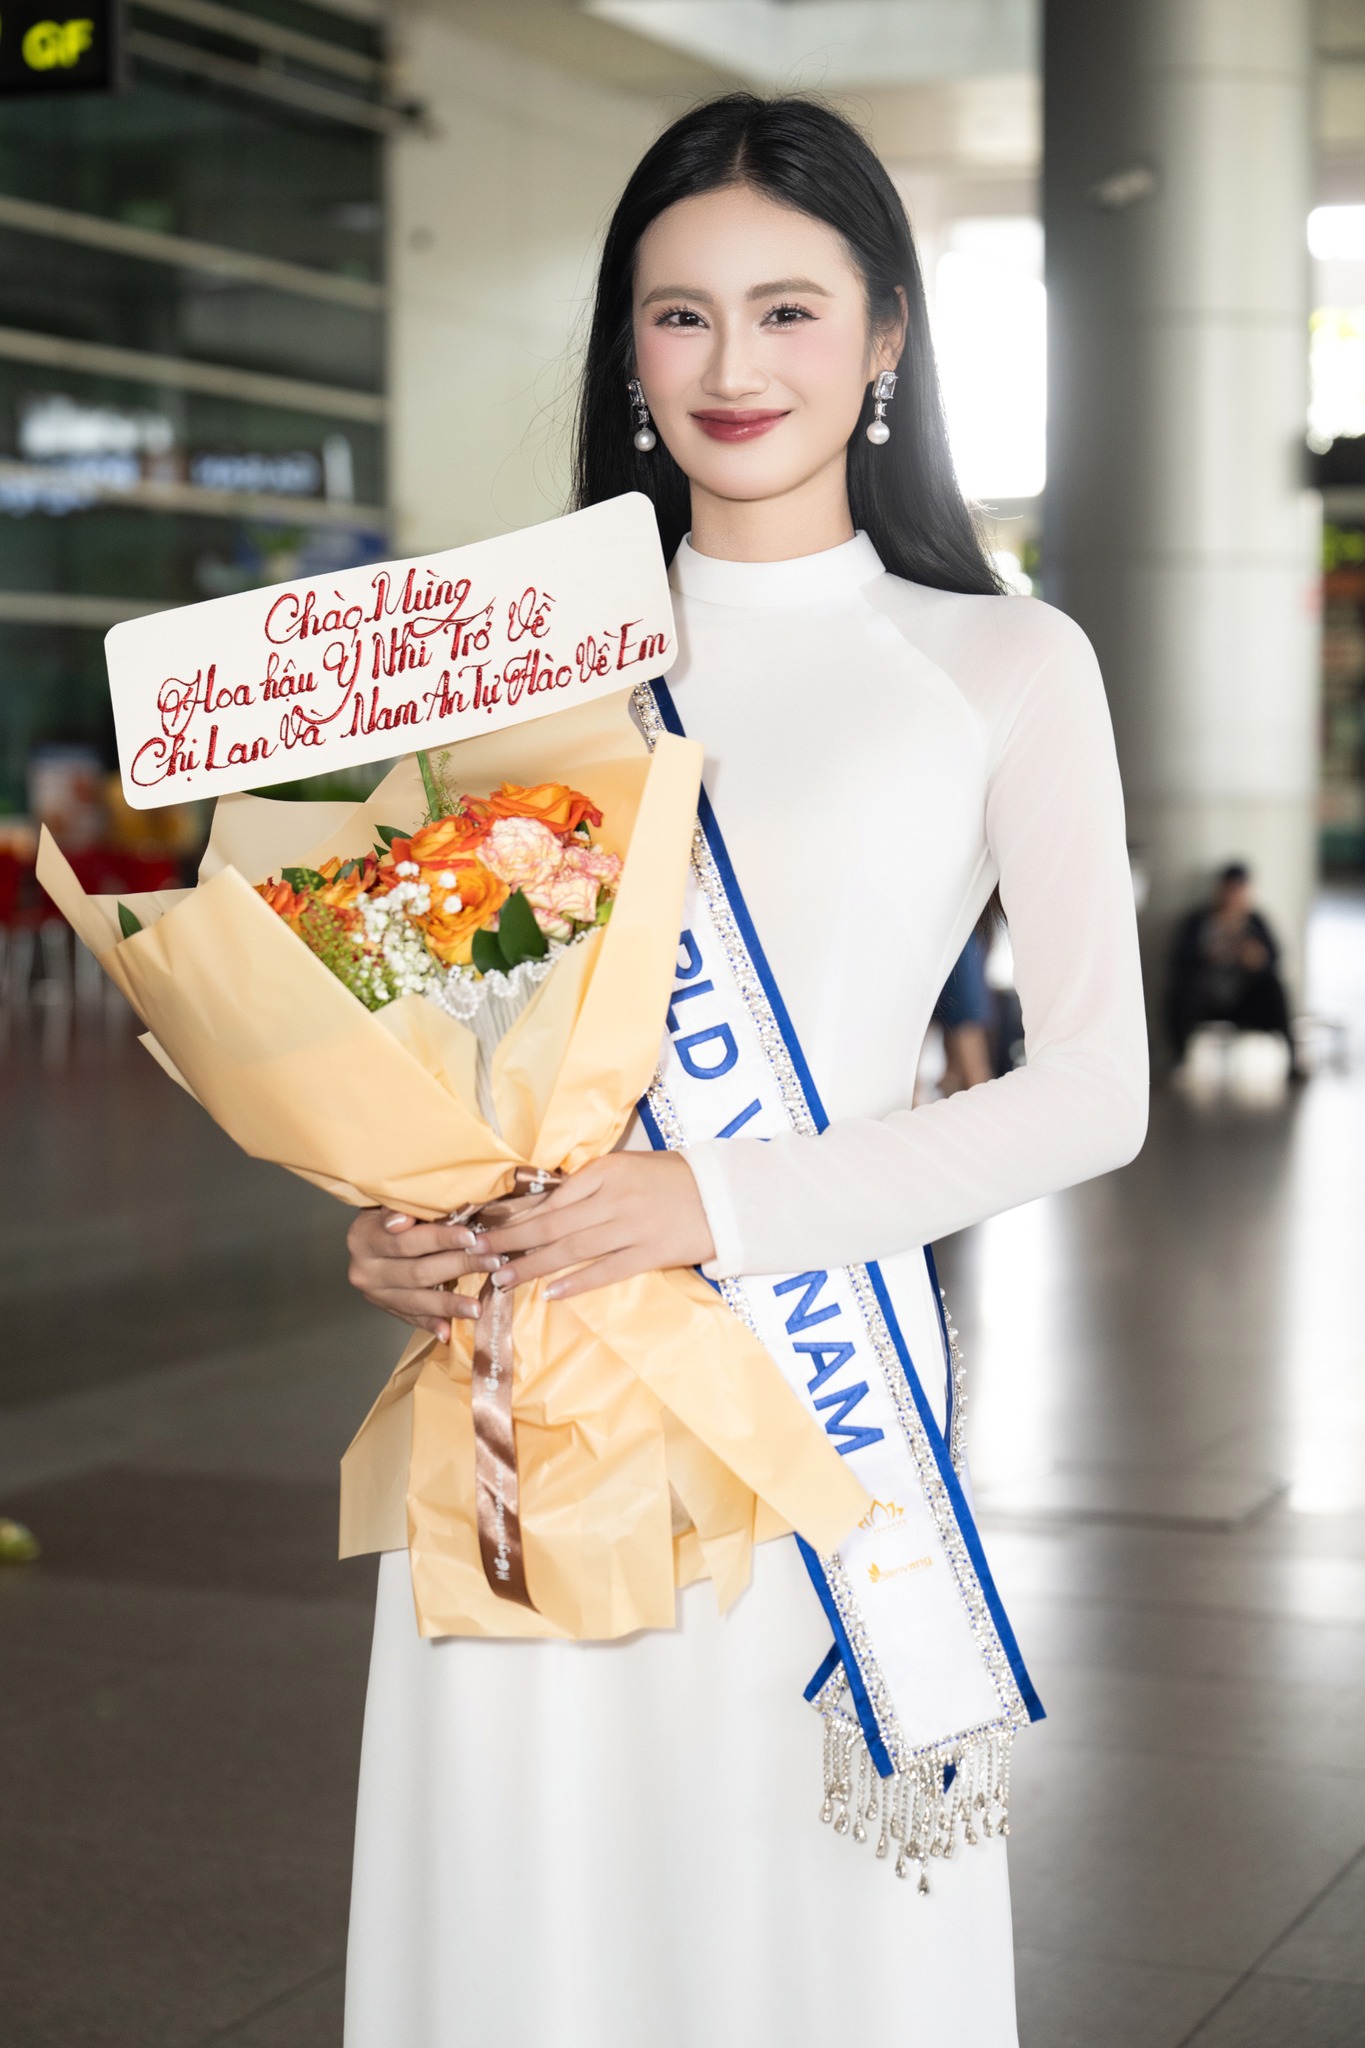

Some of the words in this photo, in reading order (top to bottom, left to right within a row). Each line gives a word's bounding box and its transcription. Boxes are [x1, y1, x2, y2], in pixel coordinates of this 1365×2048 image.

[157, 664, 256, 738] Hoa
[259, 651, 319, 702] hậu
[372, 621, 433, 680] Nhi
[443, 605, 495, 661] Trở
[507, 586, 556, 642] Về
[264, 590, 363, 644] Chào
[364, 567, 496, 638] Mừng
[131, 733, 201, 787] Chị
[204, 724, 279, 771] Lan
[280, 704, 327, 750] Và
[340, 685, 425, 738] Nam
[422, 669, 471, 722] An
[457, 659, 503, 714] Tự
[502, 648, 573, 706] Hào
[575, 630, 620, 684] Về
[616, 618, 670, 670] Em
